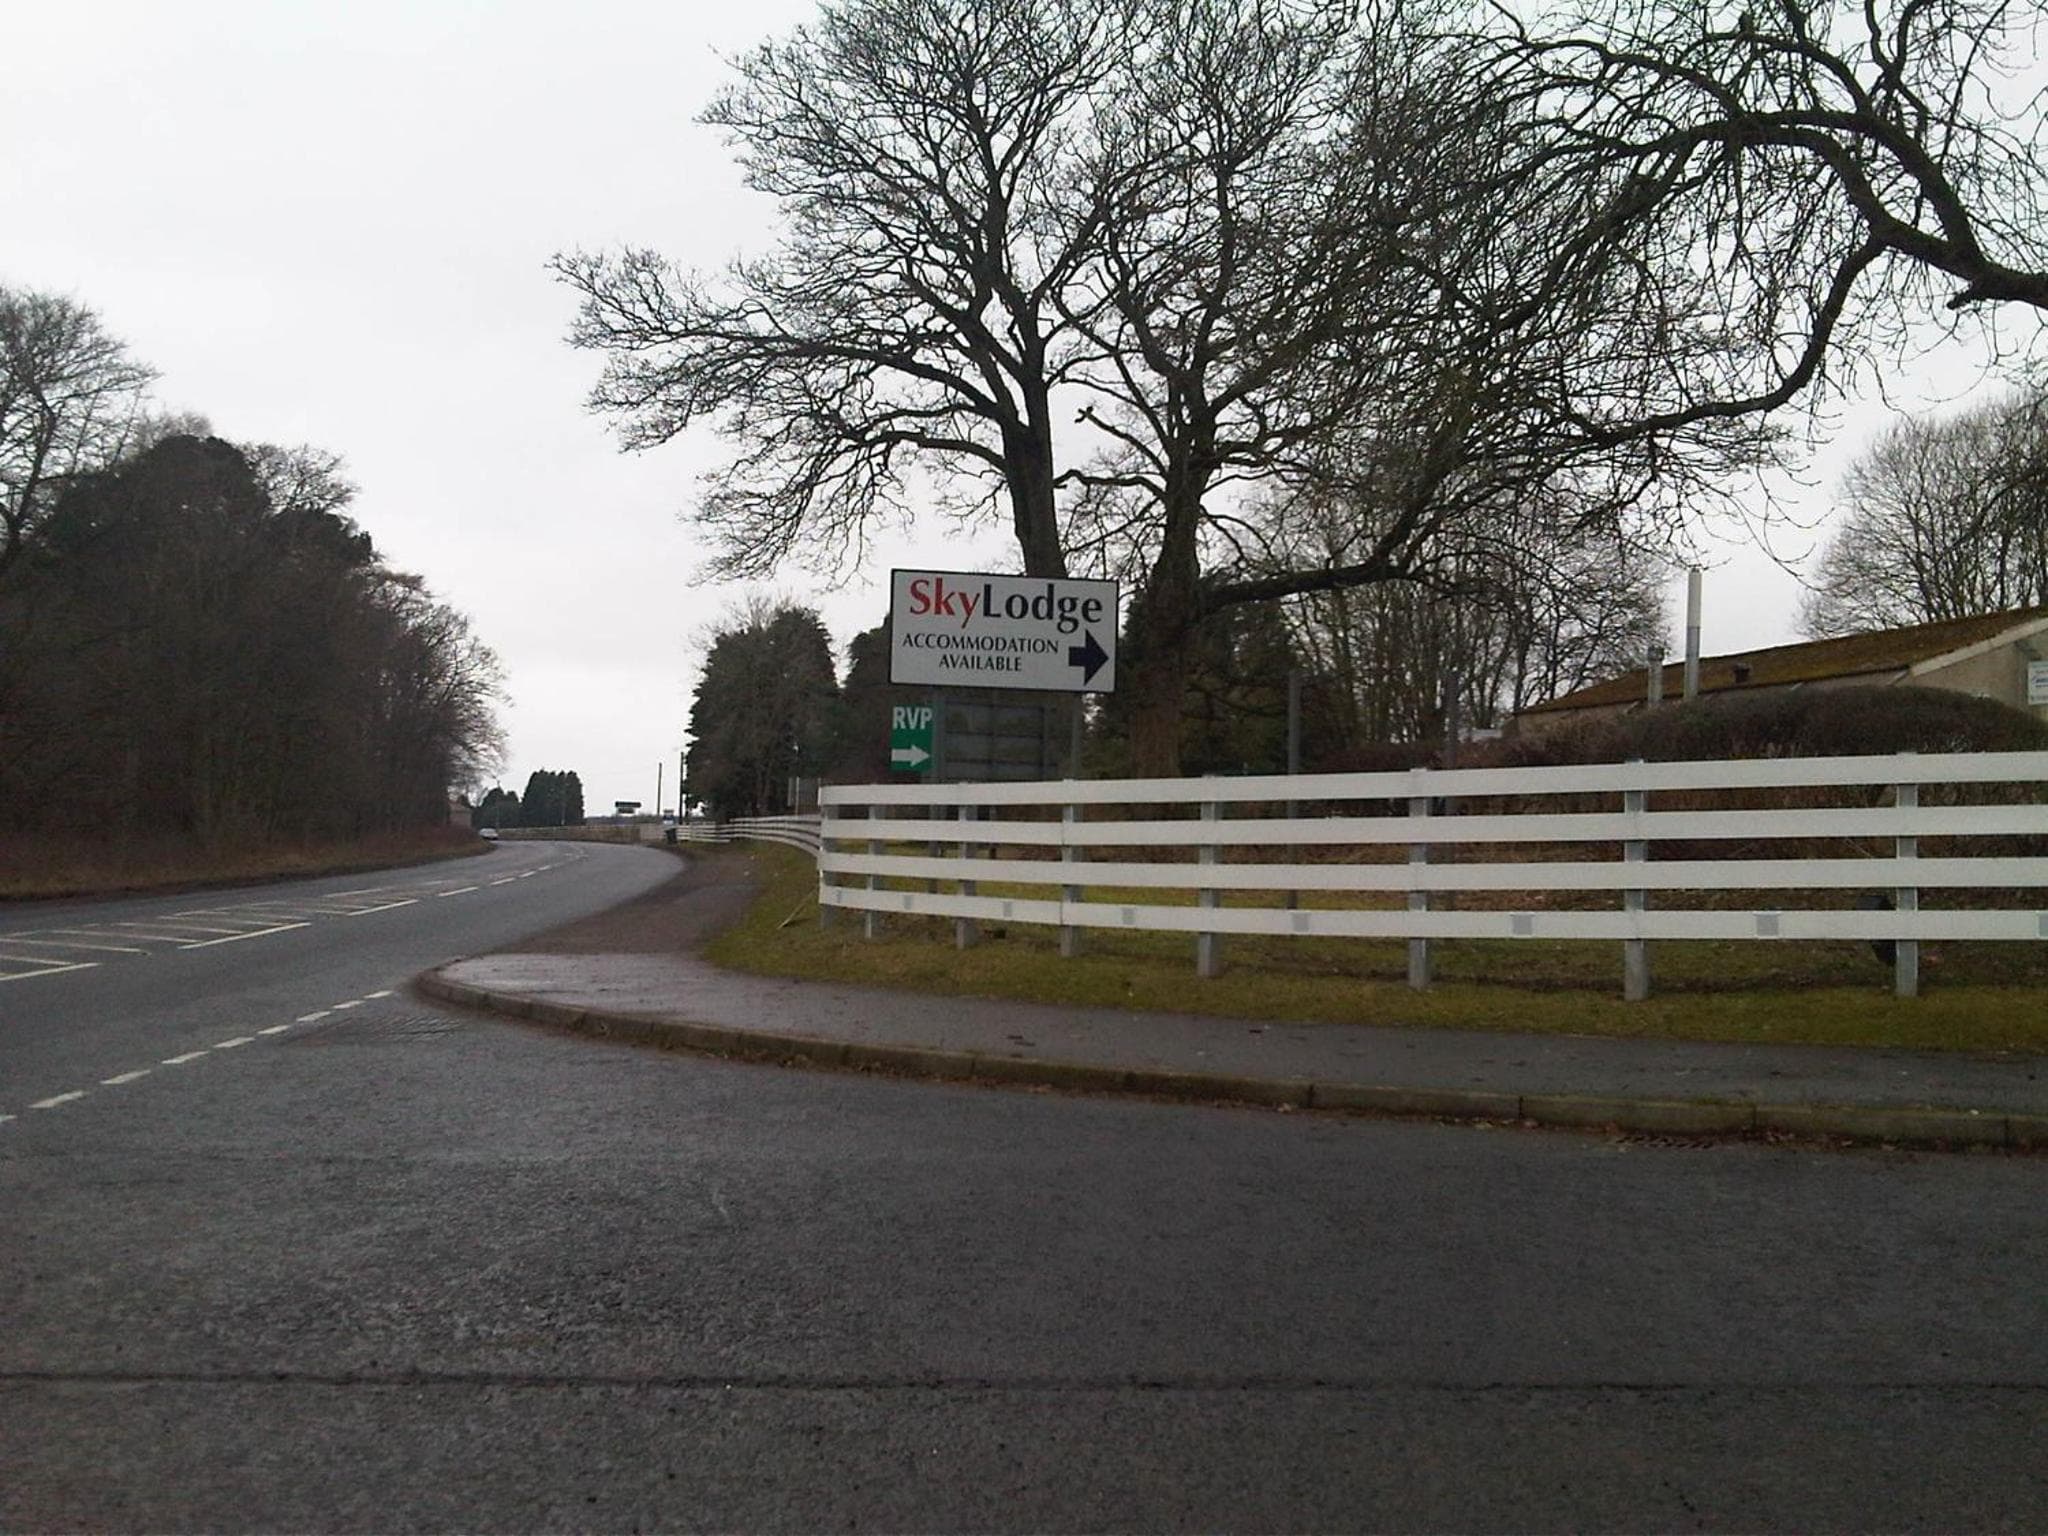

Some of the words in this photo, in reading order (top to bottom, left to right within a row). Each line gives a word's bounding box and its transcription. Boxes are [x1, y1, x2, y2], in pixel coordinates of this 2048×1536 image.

[910, 577, 1103, 634] SkyLodge
[902, 633, 1059, 654] ACCOMMODATION
[939, 654, 1022, 672] AVAILABLE
[892, 706, 933, 730] RVP
